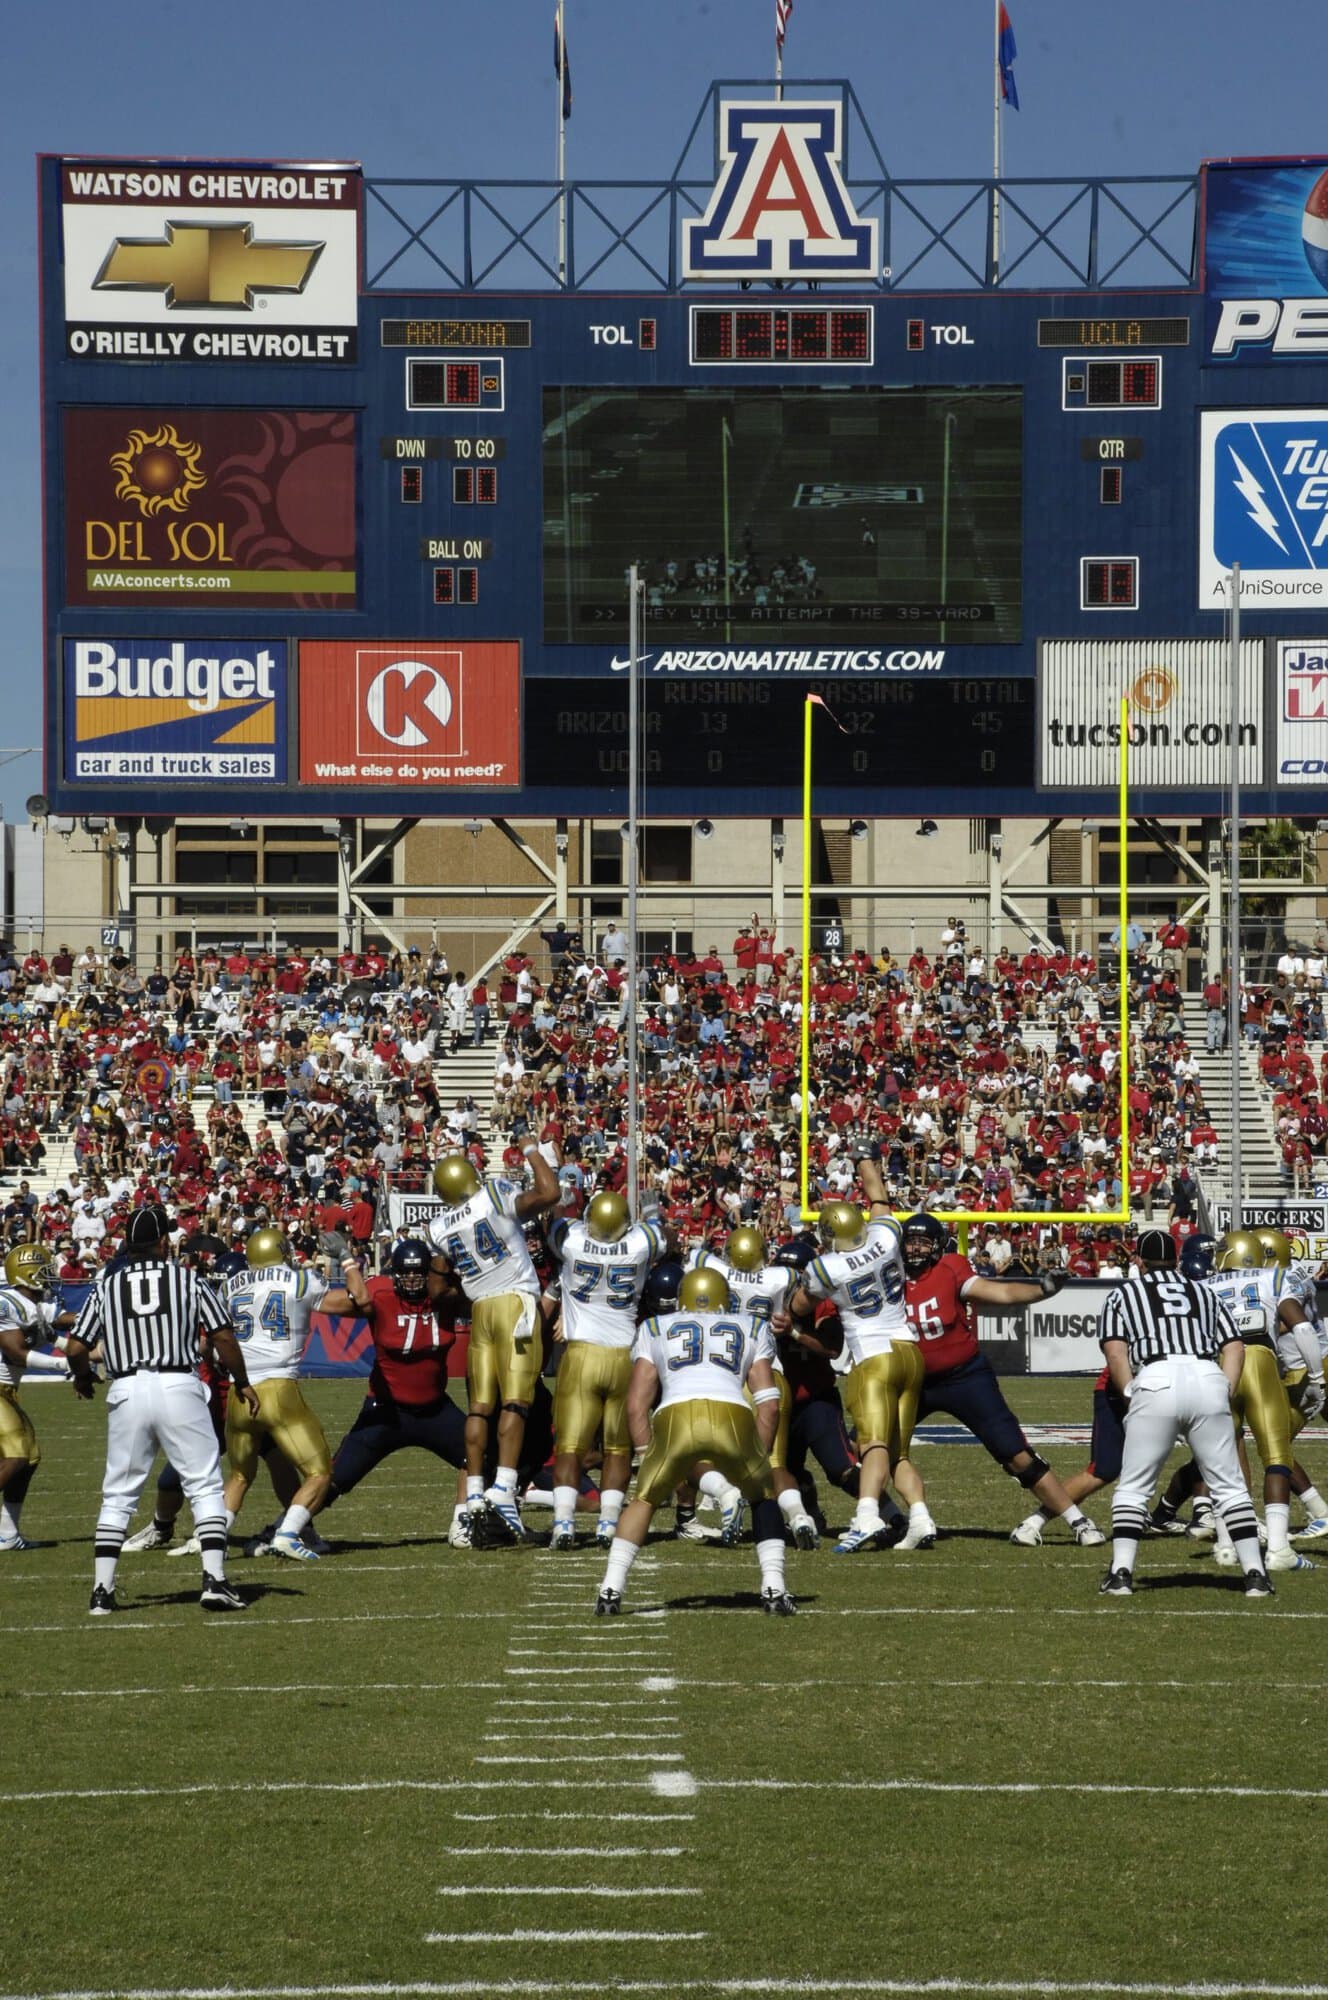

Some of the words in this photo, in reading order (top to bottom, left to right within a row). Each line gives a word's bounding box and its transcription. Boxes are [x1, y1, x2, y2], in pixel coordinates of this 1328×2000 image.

[70, 173, 180, 196] WATSON
[189, 177, 346, 200] CHEVROLET
[683, 101, 878, 278] A
[71, 331, 185, 355] O'RIELLY
[193, 334, 348, 357] CHEVROLET
[406, 322, 506, 345] ARIZONA
[590, 326, 633, 344] TOL
[719, 313, 867, 356] 12:26
[909, 322, 923, 348] 3
[931, 327, 974, 345] TOL
[1081, 322, 1142, 345] UCLA
[447, 366, 478, 404] 0
[1124, 363, 1156, 402] 0
[396, 440, 426, 458] DWN
[455, 440, 471, 458] TO
[476, 440, 495, 458] GO
[1099, 439, 1125, 459] QTR
[1282, 439, 1328, 475] Tu
[403, 470, 421, 500] 4
[466, 470, 496, 500] 10
[86, 521, 152, 561] DEL
[167, 521, 234, 561] SOL
[429, 541, 459, 559] BALL
[463, 541, 482, 559] ON
[93, 574, 231, 589] AVAconcerts.com
[435, 570, 477, 601] 21
[1213, 580, 1225, 595] A
[642, 608, 677, 619] HEY
[690, 608, 736, 619] WILL
[751, 608, 833, 619] ATTEMPT
[850, 608, 882, 619] THE
[899, 608, 981, 619] 39-YARD
[653, 651, 945, 671] ARIZONAATHLETICS.COM
[1289, 652, 1328, 671] Ja
[76, 642, 275, 712] Budget
[664, 682, 770, 703] RUSHING
[948, 682, 1025, 703] TOTAL
[558, 712, 661, 733] ARIZOA
[700, 712, 728, 733] 13
[846, 712, 876, 733] 32
[972, 712, 1002, 732] 45
[1049, 719, 1257, 747] tucson.com
[80, 758, 111, 774] car
[119, 757, 153, 774] and
[161, 757, 212, 775] truck
[219, 757, 271, 775] sales
[315, 763, 355, 777] What
[361, 763, 392, 777] else
[398, 764, 417, 778] do
[422, 767, 450, 782] you
[454, 763, 503, 777] need?
[599, 751, 662, 772] UCA
[708, 751, 723, 772] 0
[853, 751, 867, 772] 0
[981, 751, 996, 771] 0
[103, 930, 116, 945] 27
[825, 930, 840, 946] 28
[1221, 1210, 1324, 1229] BUEGGER'S
[583, 1240, 628, 1255] BROWN
[846, 1241, 886, 1271] BLAKE
[230, 1268, 292, 1292] BOSWORTH
[569, 1259, 638, 1310] 75
[727, 1268, 764, 1285] PRICE
[127, 1271, 163, 1316] U
[846, 1258, 903, 1320] 56
[1157, 1283, 1191, 1316] S
[230, 1290, 291, 1343] 54
[977, 1315, 1019, 1341] ILK
[667, 1321, 745, 1376] 33
